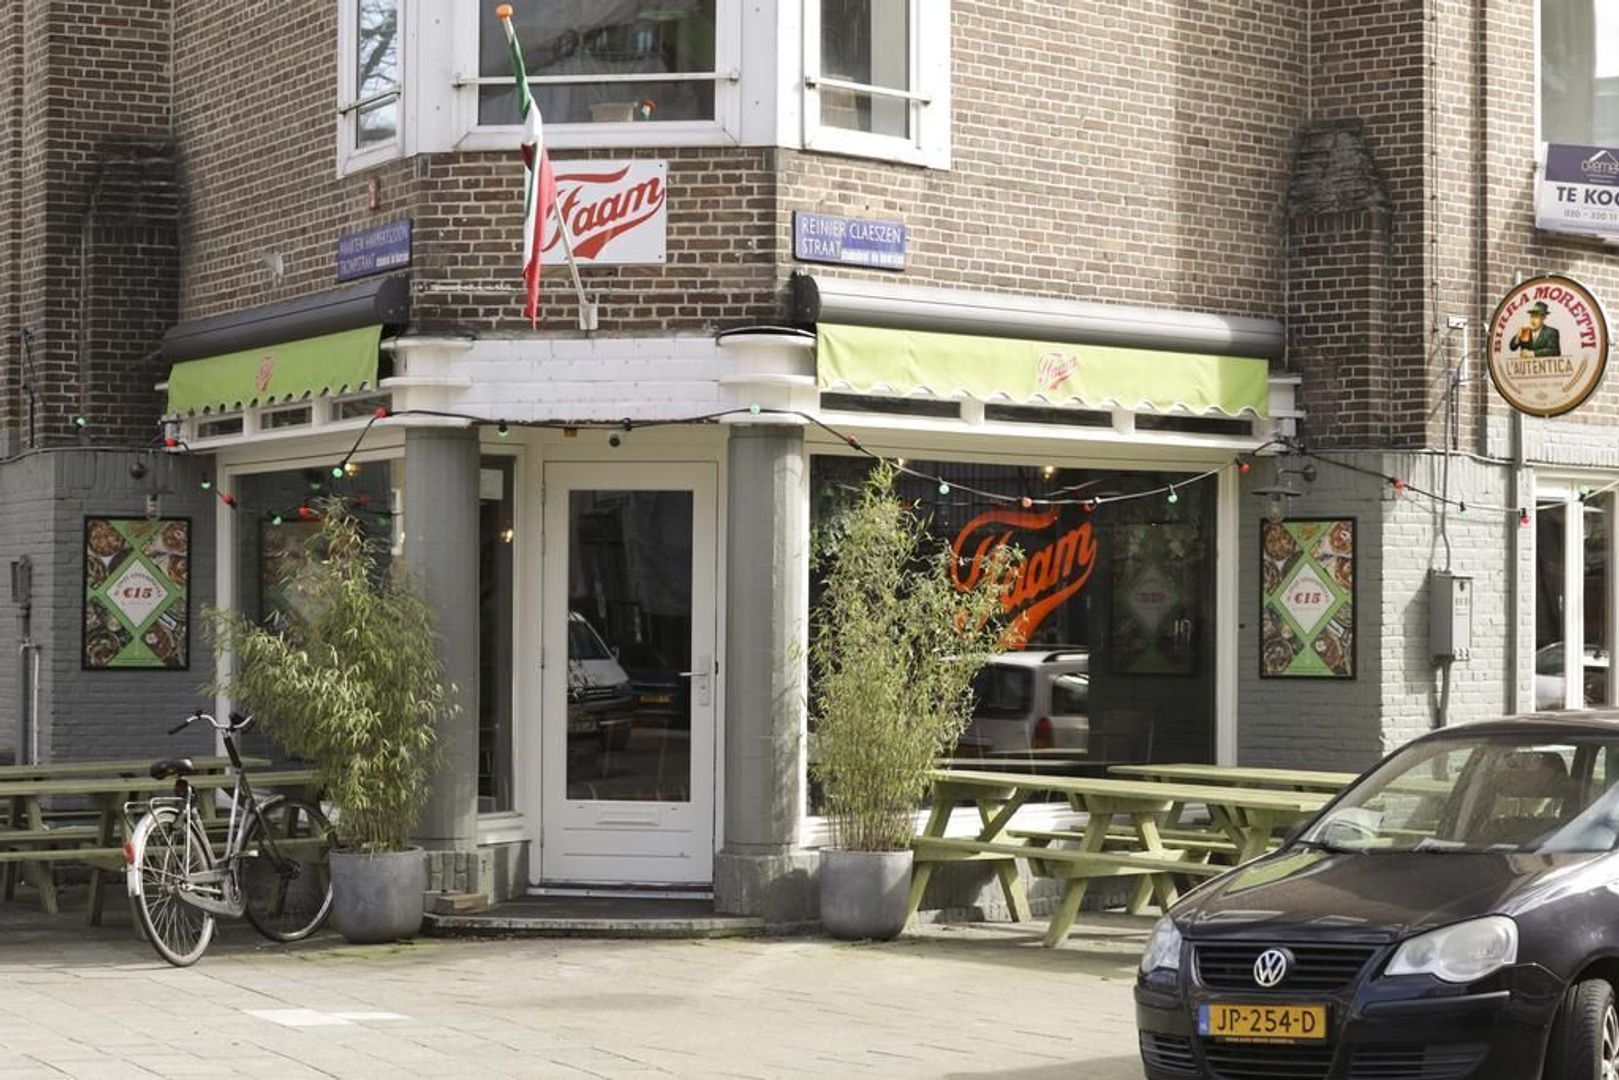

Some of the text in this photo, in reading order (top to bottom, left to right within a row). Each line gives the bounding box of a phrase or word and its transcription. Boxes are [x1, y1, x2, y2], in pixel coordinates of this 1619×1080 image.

[1556, 186, 1577, 203] TE
[801, 217, 901, 243] REINIER CLAESZEN
[801, 239, 841, 257] STRAAT
[1494, 286, 1597, 353] BIRRA MORETTI
[1506, 358, 1574, 377] L'AUTENTICA
[123, 587, 153, 599] €15
[1294, 592, 1322, 604] €15
[1217, 1008, 1316, 1034] JP-254-D
